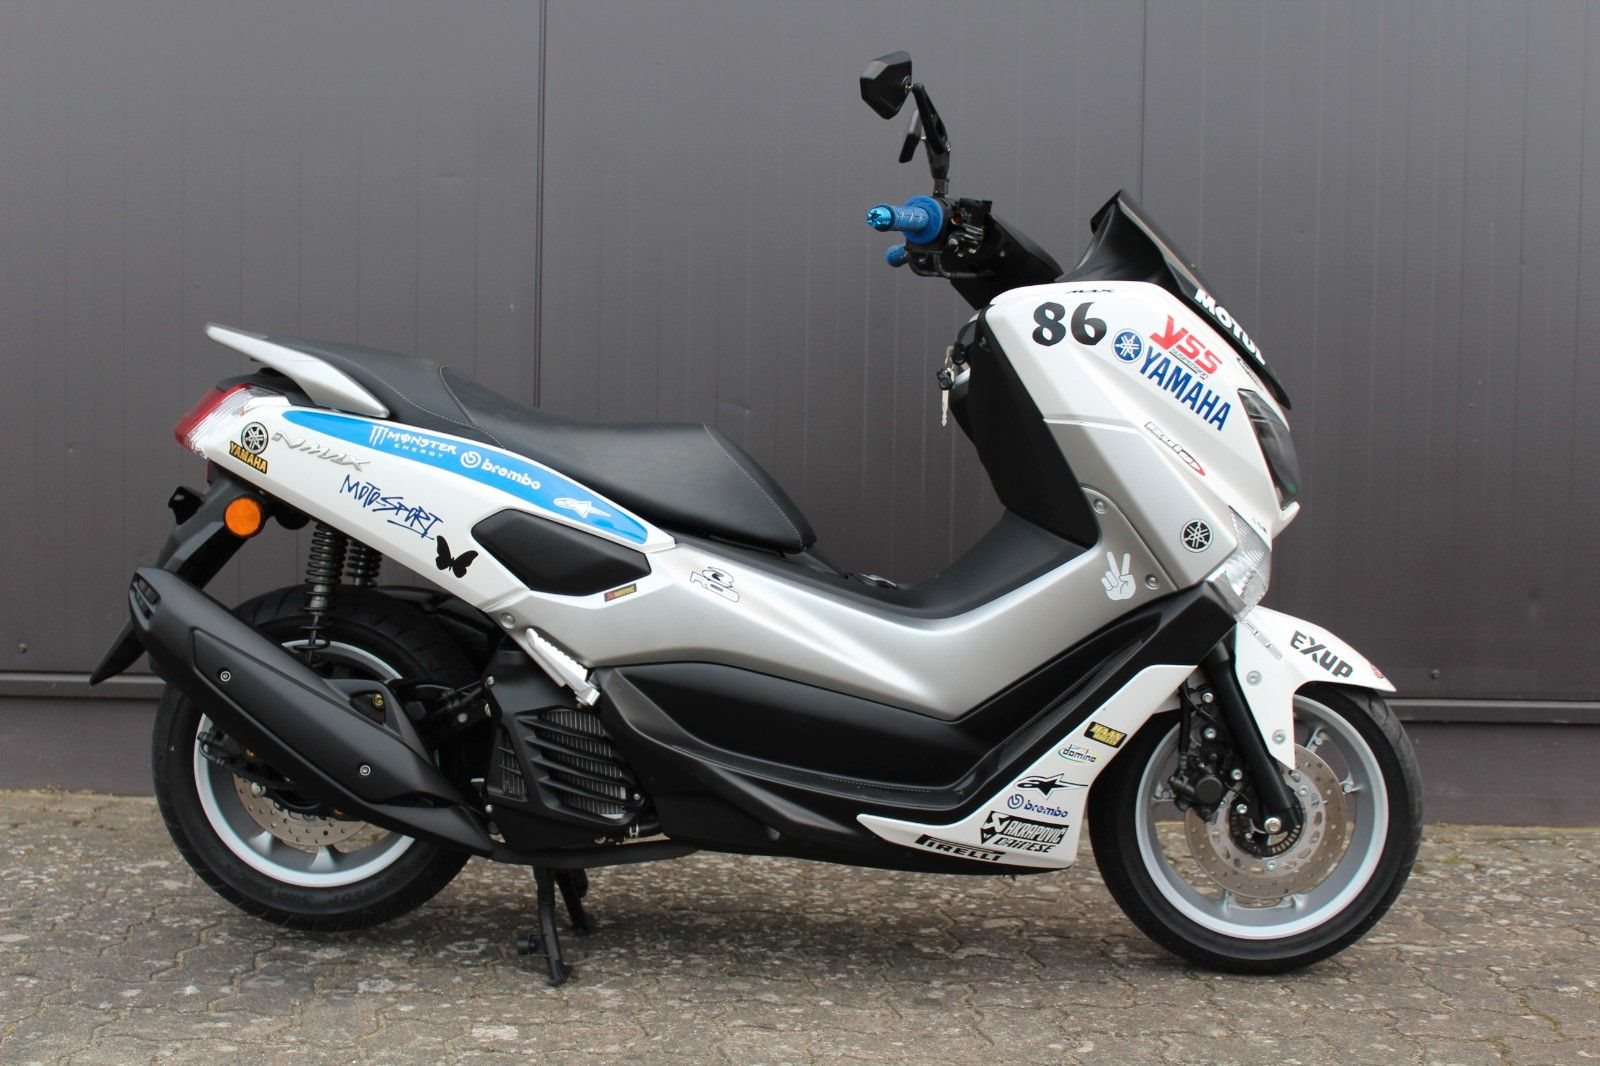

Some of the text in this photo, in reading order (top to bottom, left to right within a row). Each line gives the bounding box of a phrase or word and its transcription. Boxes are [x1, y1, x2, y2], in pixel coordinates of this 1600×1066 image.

[1032, 301, 1107, 346] 86
[1150, 314, 1223, 375] YSS
[1139, 346, 1231, 431] YAMAHA
[229, 441, 268, 475] YAMAHA
[481, 458, 541, 490] brembo
[1290, 630, 1353, 678] EXUP
[1024, 800, 1069, 818] brembo
[915, 834, 1006, 862] PIRELLI
